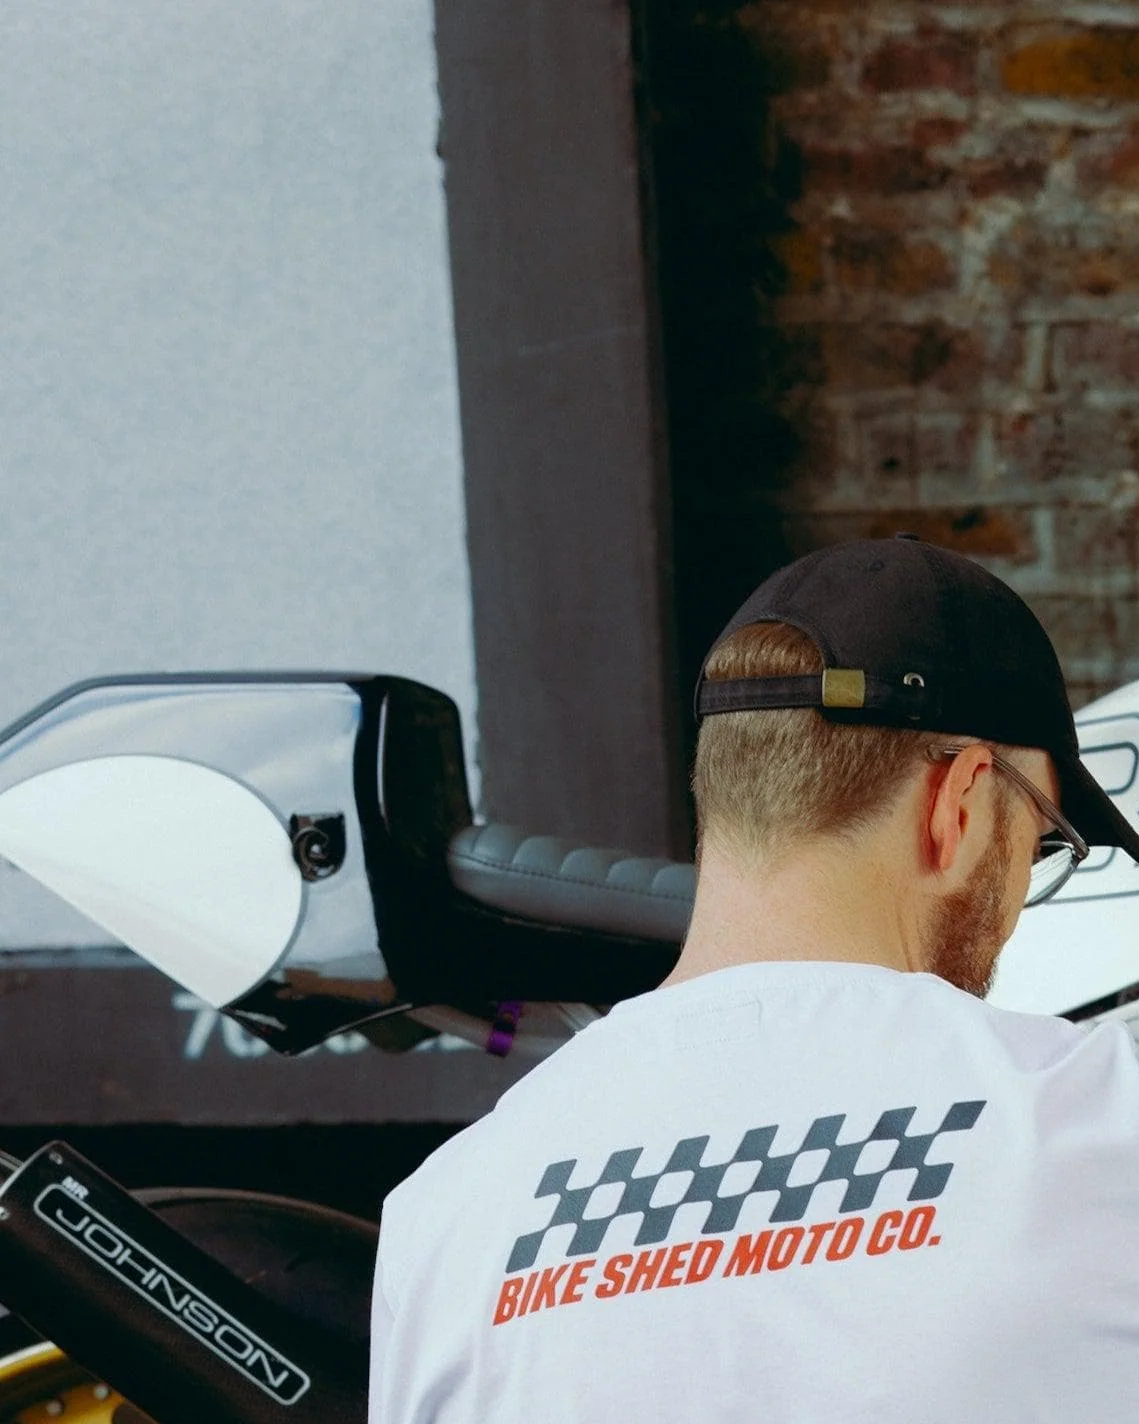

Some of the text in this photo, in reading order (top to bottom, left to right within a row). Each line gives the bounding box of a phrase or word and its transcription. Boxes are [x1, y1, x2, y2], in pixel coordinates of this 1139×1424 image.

[61, 1175, 89, 1201] MR
[55, 1207, 290, 1389] JOHNSON
[492, 1204, 942, 1327] BIKE SHED MOTO CO.
